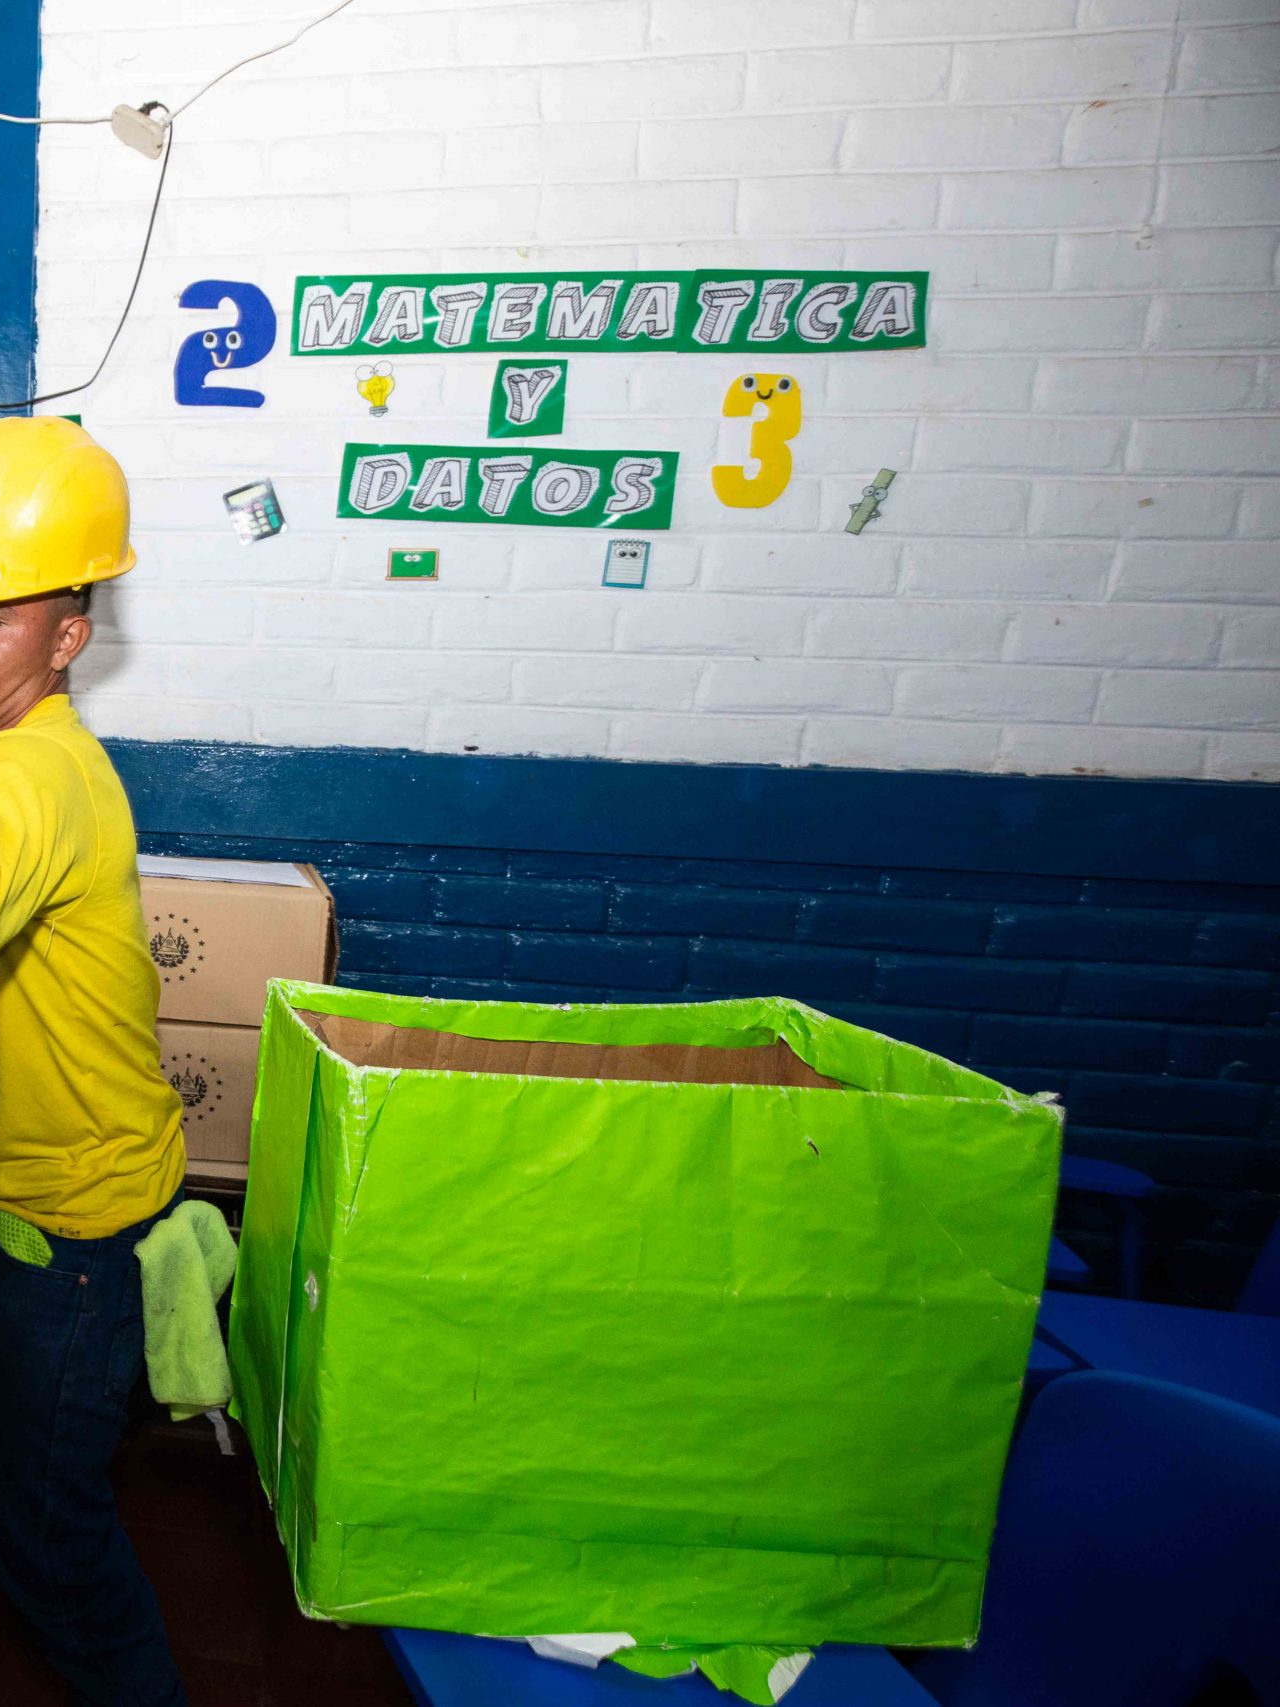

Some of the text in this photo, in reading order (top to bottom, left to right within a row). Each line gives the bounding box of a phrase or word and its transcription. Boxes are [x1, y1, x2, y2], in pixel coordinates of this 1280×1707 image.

[299, 282, 917, 347] MATEMATICA
[504, 366, 552, 426] Y
[350, 456, 658, 515] DATOS
